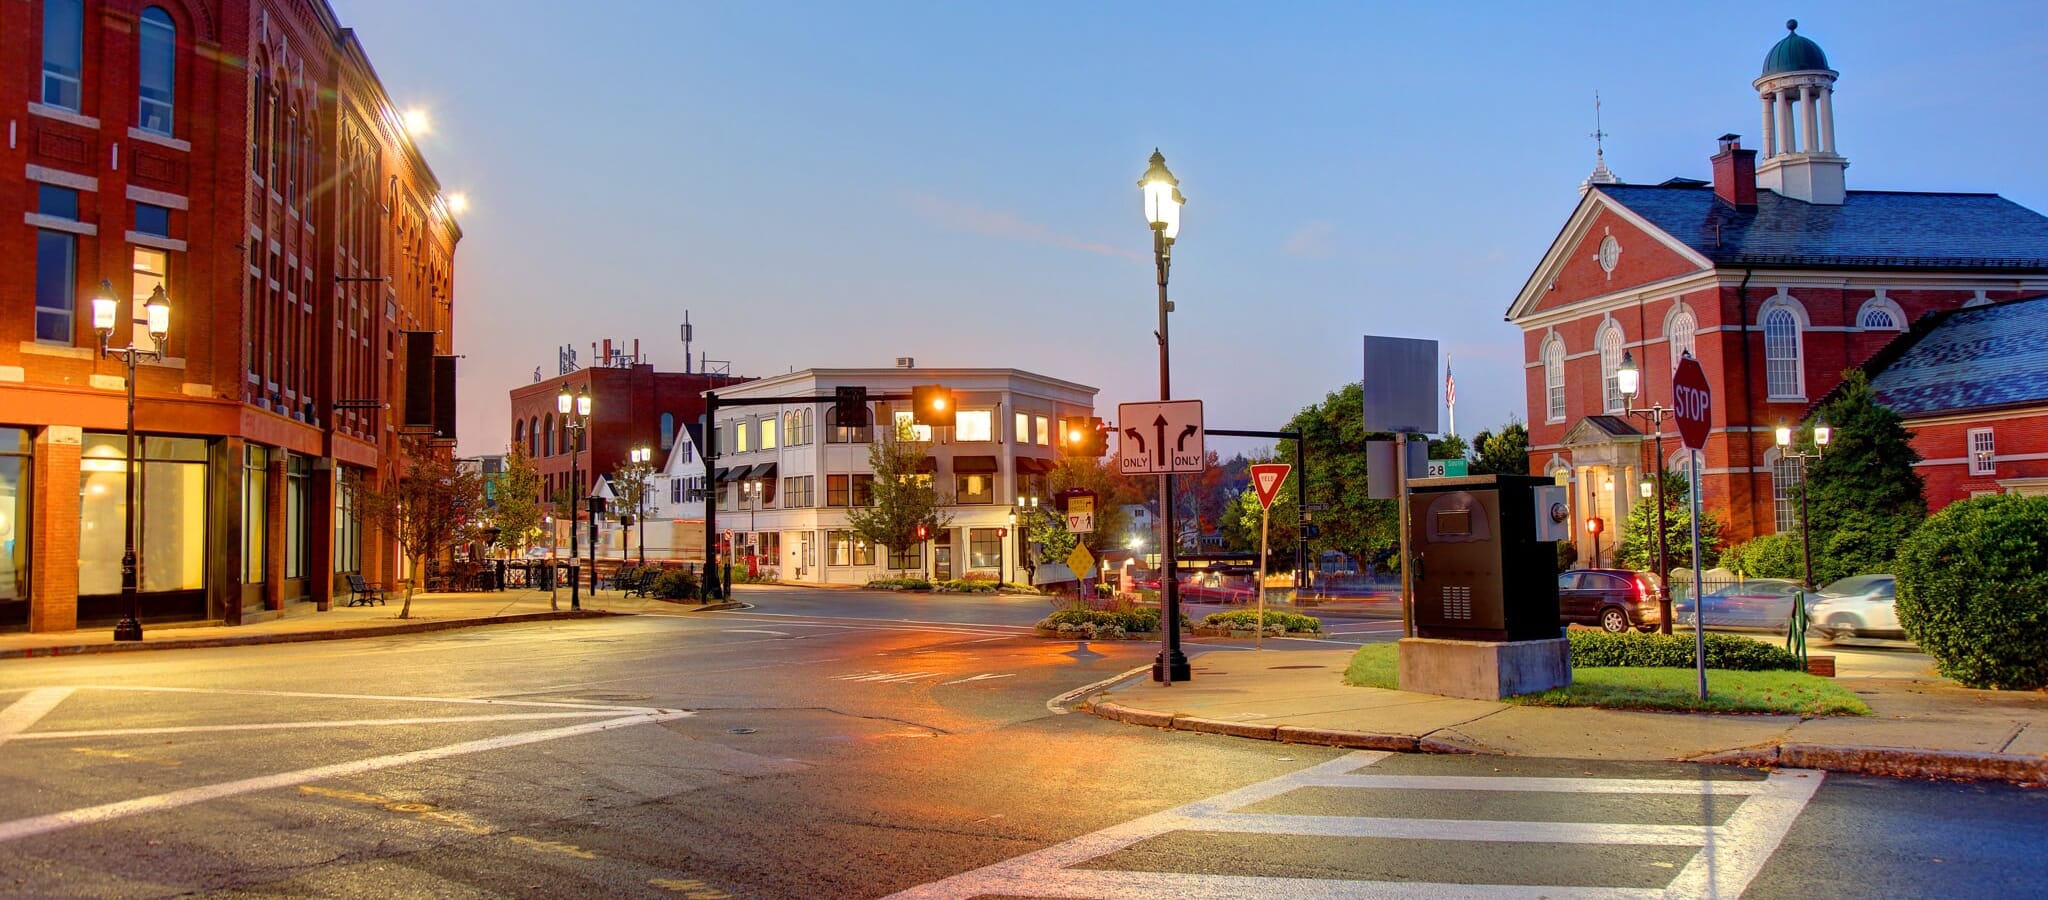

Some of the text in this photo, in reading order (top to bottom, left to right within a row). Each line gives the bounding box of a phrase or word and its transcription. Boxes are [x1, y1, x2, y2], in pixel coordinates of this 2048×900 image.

[1675, 384, 1709, 422] STOP
[1123, 458, 1148, 468] ONLY
[1174, 455, 1200, 466] ONLY
[1429, 465, 1444, 476] 28
